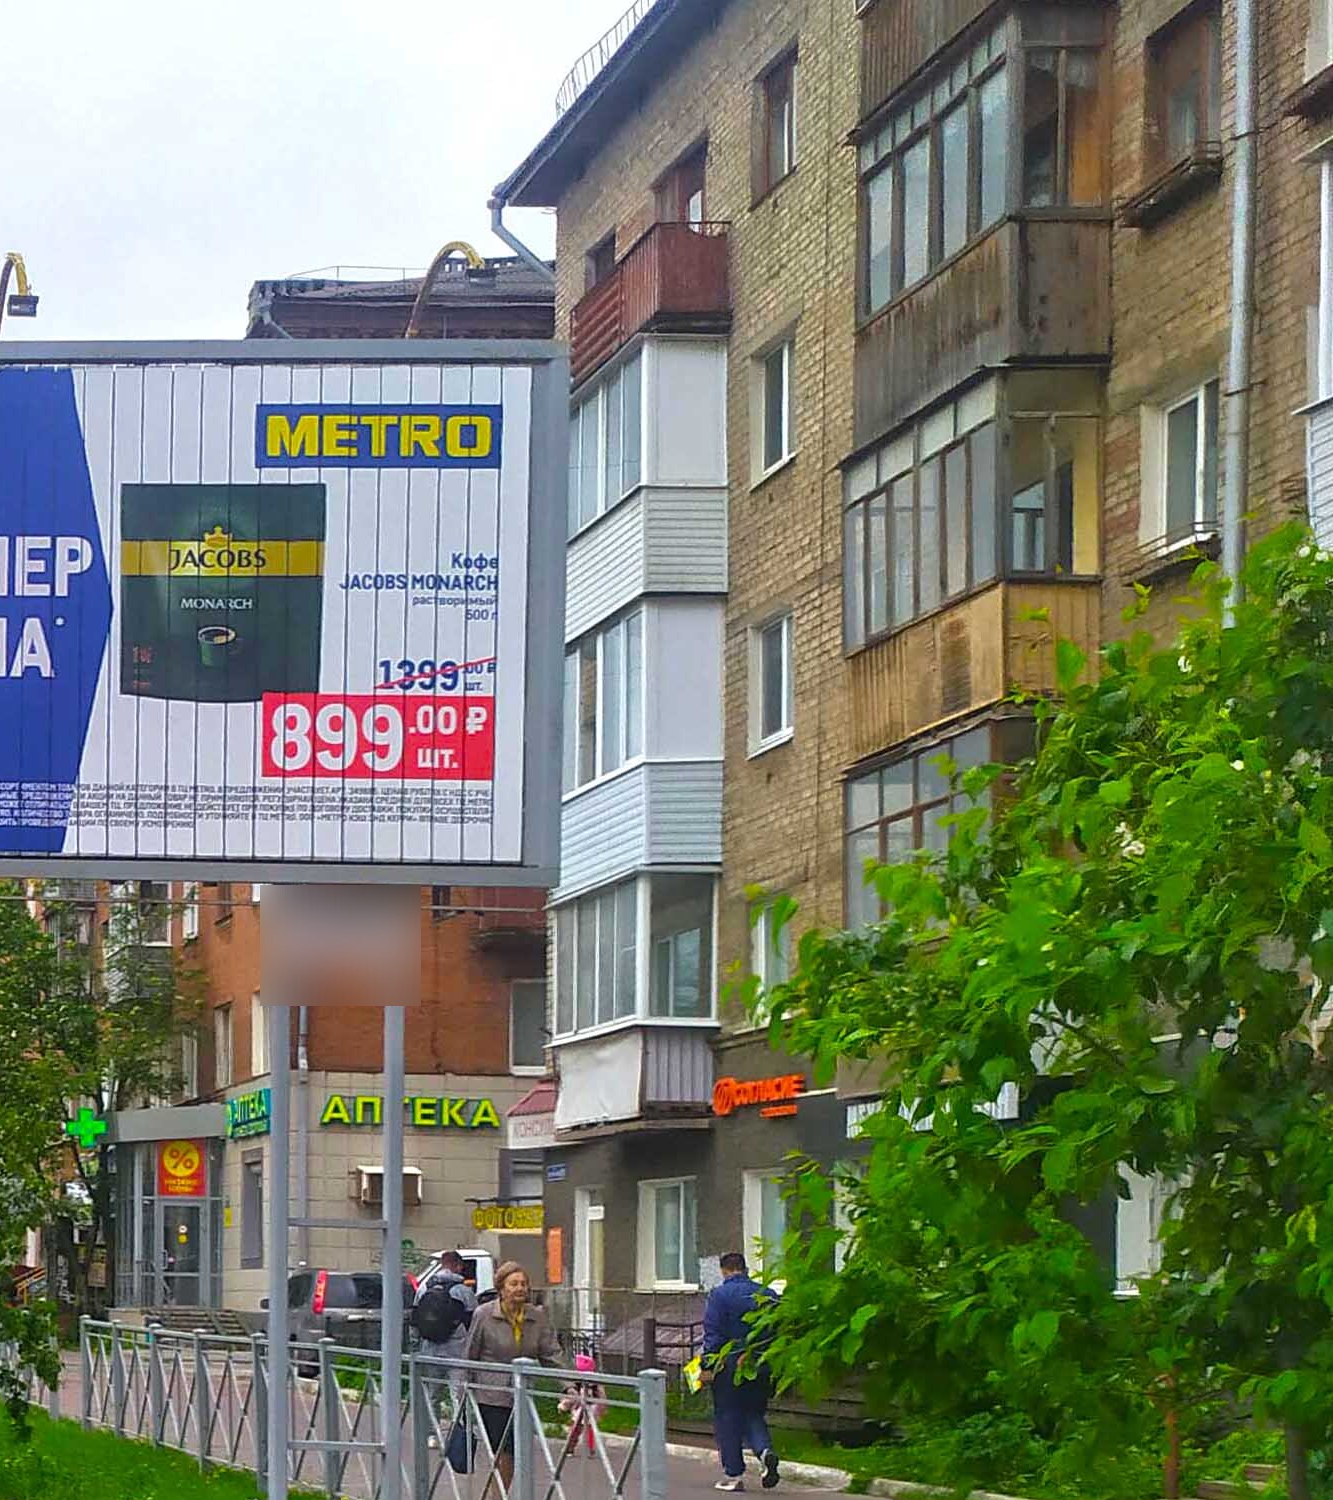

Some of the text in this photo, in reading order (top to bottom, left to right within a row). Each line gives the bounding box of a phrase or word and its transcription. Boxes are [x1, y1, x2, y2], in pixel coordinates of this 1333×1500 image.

[266, 415, 492, 457] METRO
[168, 549, 266, 570] JACOBS
[451, 552, 498, 575] Кофе
[339, 574, 499, 591] JACOBS MONARCH
[180, 597, 254, 610] MONARCH
[411, 594, 498, 607] растворимый
[465, 609, 489, 620] 500
[270, 702, 404, 772] 899
[319, 1094, 502, 1128] АПЕКА
